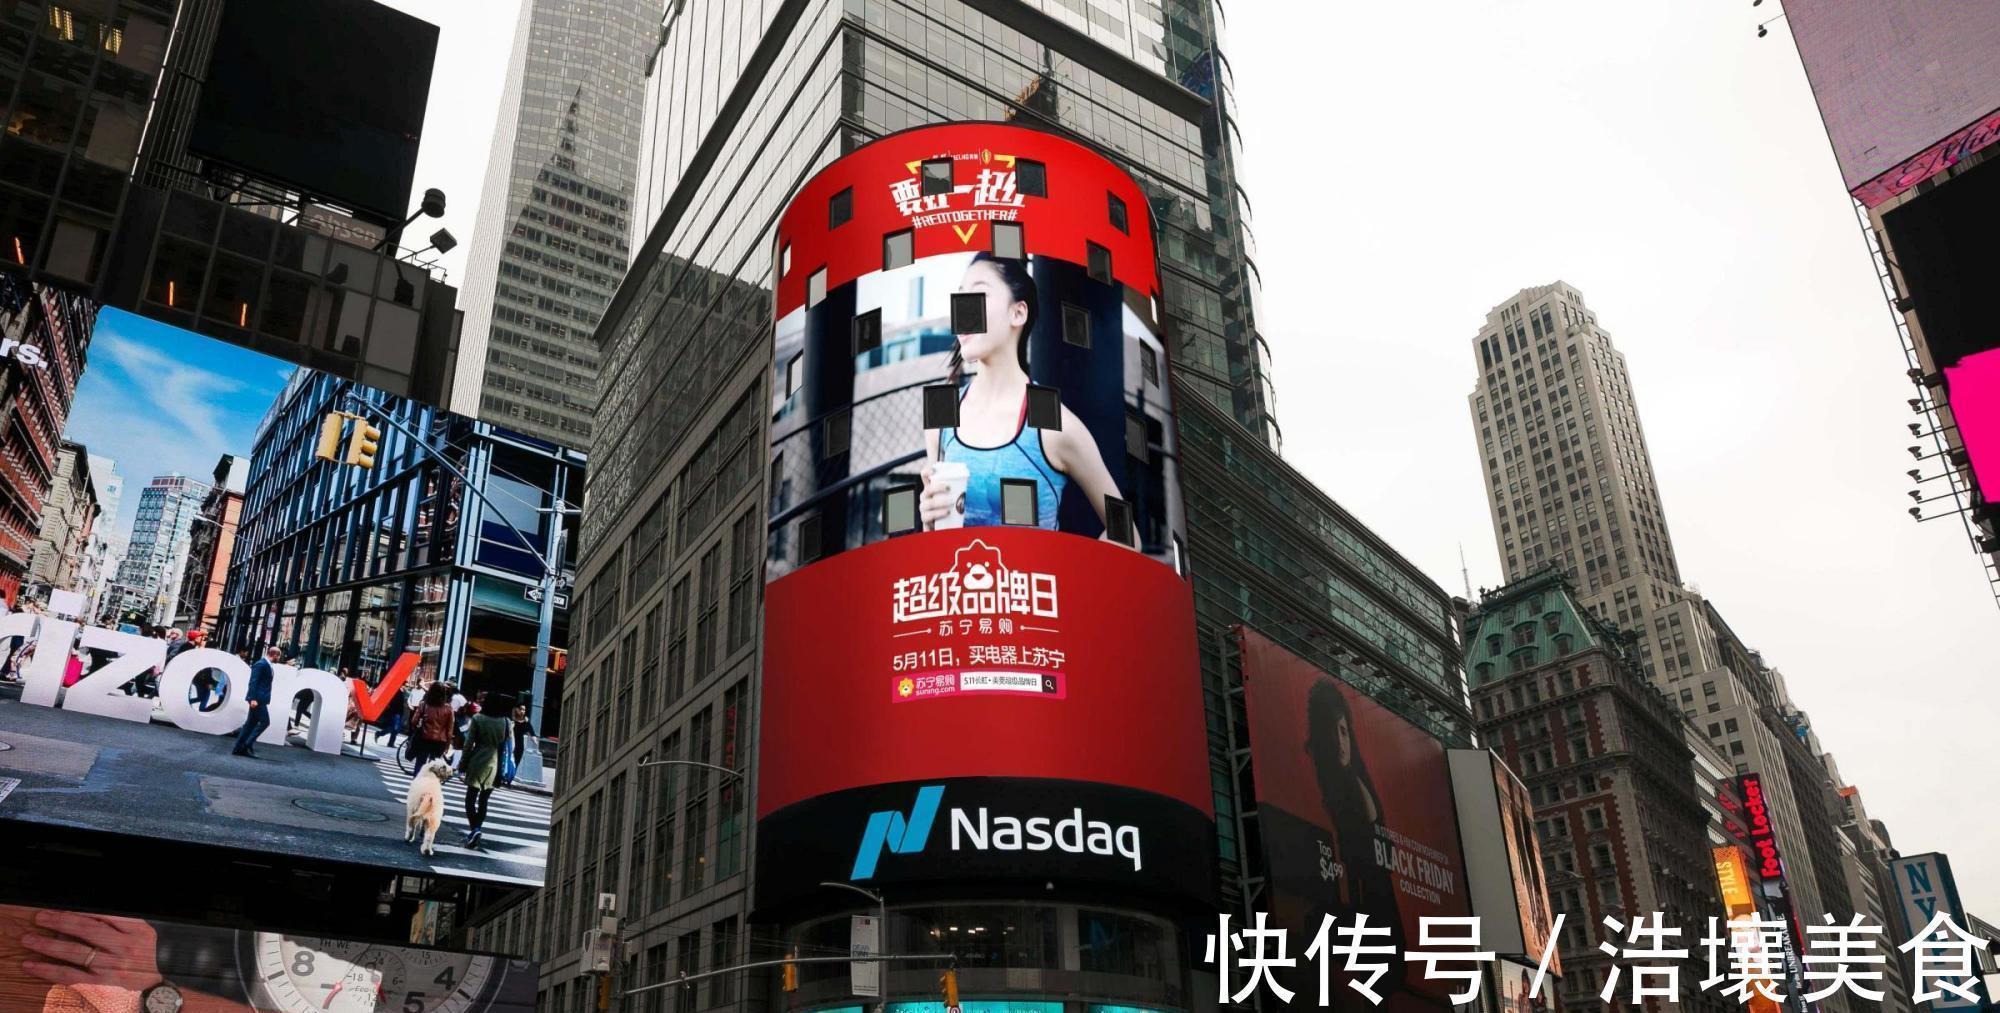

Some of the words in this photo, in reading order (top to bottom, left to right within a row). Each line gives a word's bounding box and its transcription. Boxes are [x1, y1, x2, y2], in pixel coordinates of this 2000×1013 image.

[0, 338, 48, 369] rs.
[893, 567, 1058, 624] 超级品牌日
[939, 618, 1013, 637] 苏宁易购
[916, 674, 955, 690] 苏宁易购
[916, 686, 955, 697] suning.com
[1744, 779, 1769, 836] Locker
[951, 808, 1142, 872] Nasdaq
[1317, 840, 1333, 860] Top
[1374, 838, 1416, 879] BLACK
[1416, 857, 1454, 895] FRIDAY
[1756, 838, 1780, 877] Foot
[1400, 879, 1441, 904] COLLECTION
[291, 950, 316, 977] 8
[433, 966, 456, 990] 4
[403, 991, 425, 1013] 5
